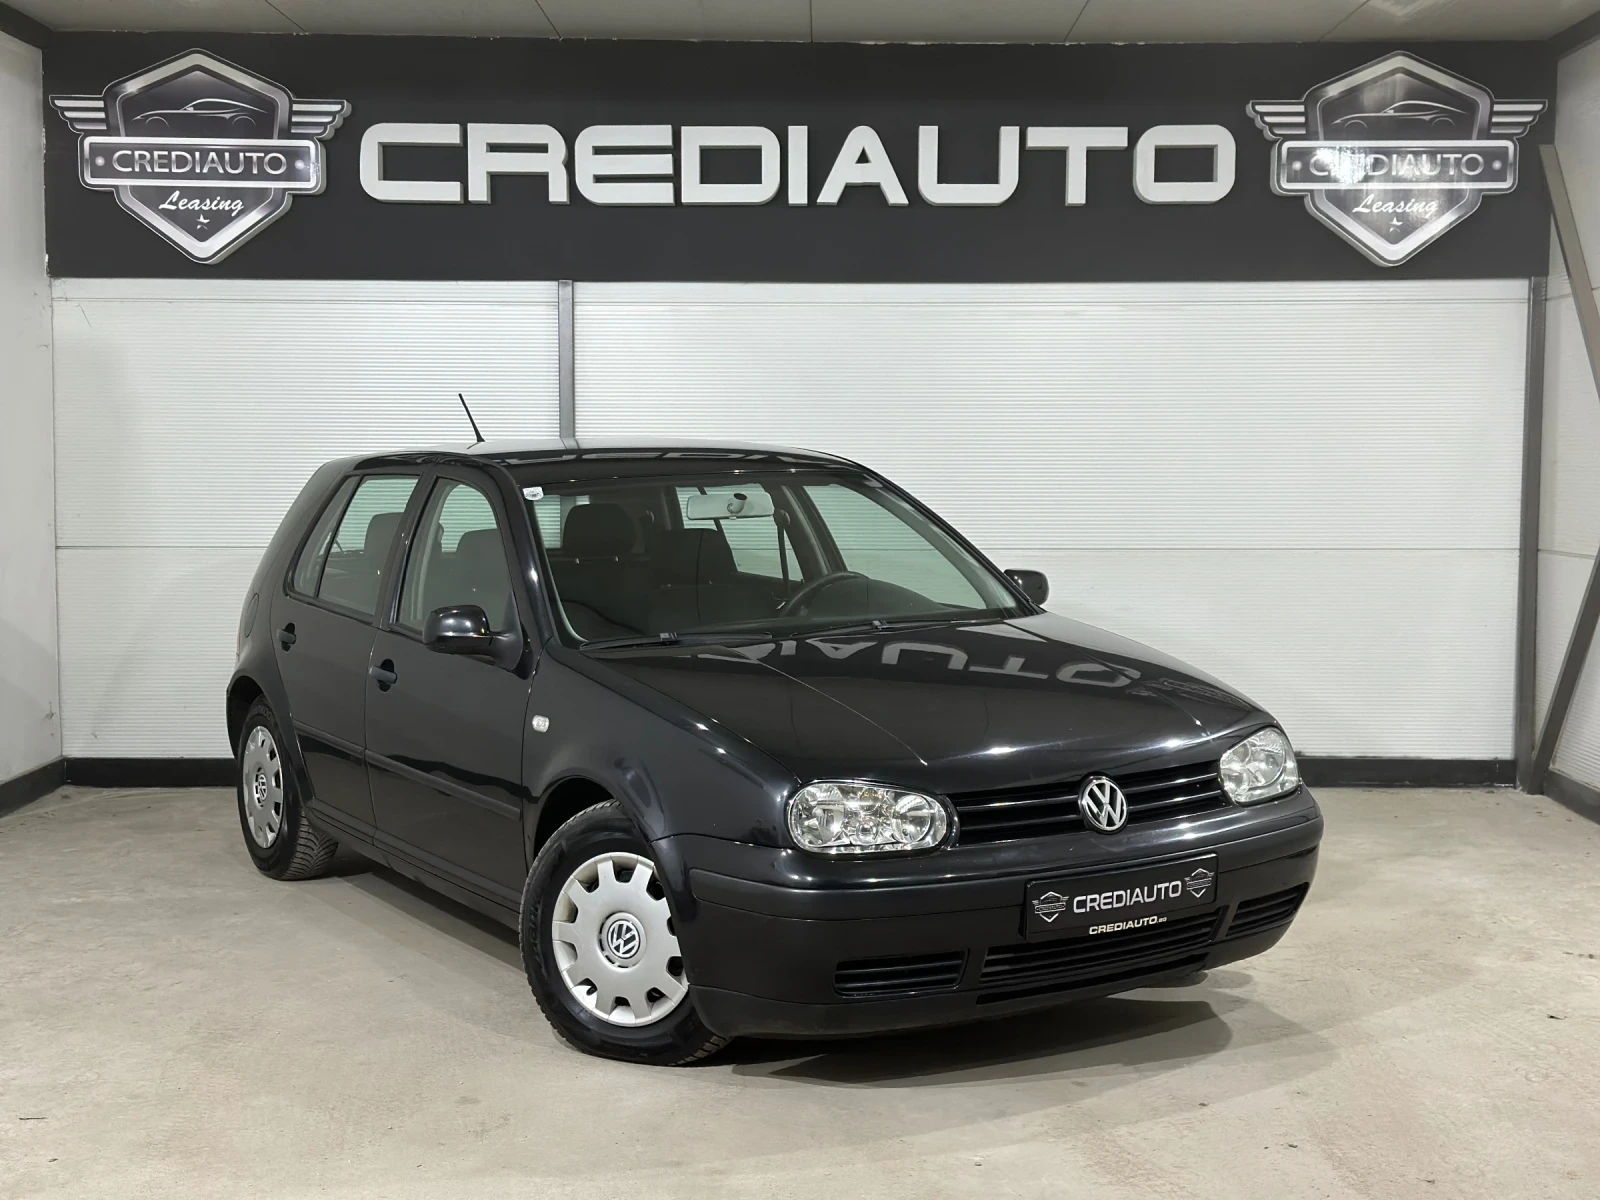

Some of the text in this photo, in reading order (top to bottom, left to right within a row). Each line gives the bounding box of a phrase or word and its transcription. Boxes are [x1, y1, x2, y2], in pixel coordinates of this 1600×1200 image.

[111, 149, 288, 176] CREDIAUTO
[359, 122, 1236, 206] CREDIAUTO
[1309, 152, 1485, 177] CDIAUTO
[158, 191, 244, 217] Leasing
[1352, 192, 1440, 218] Leasing
[1073, 881, 1182, 914] CREDIAUTO
